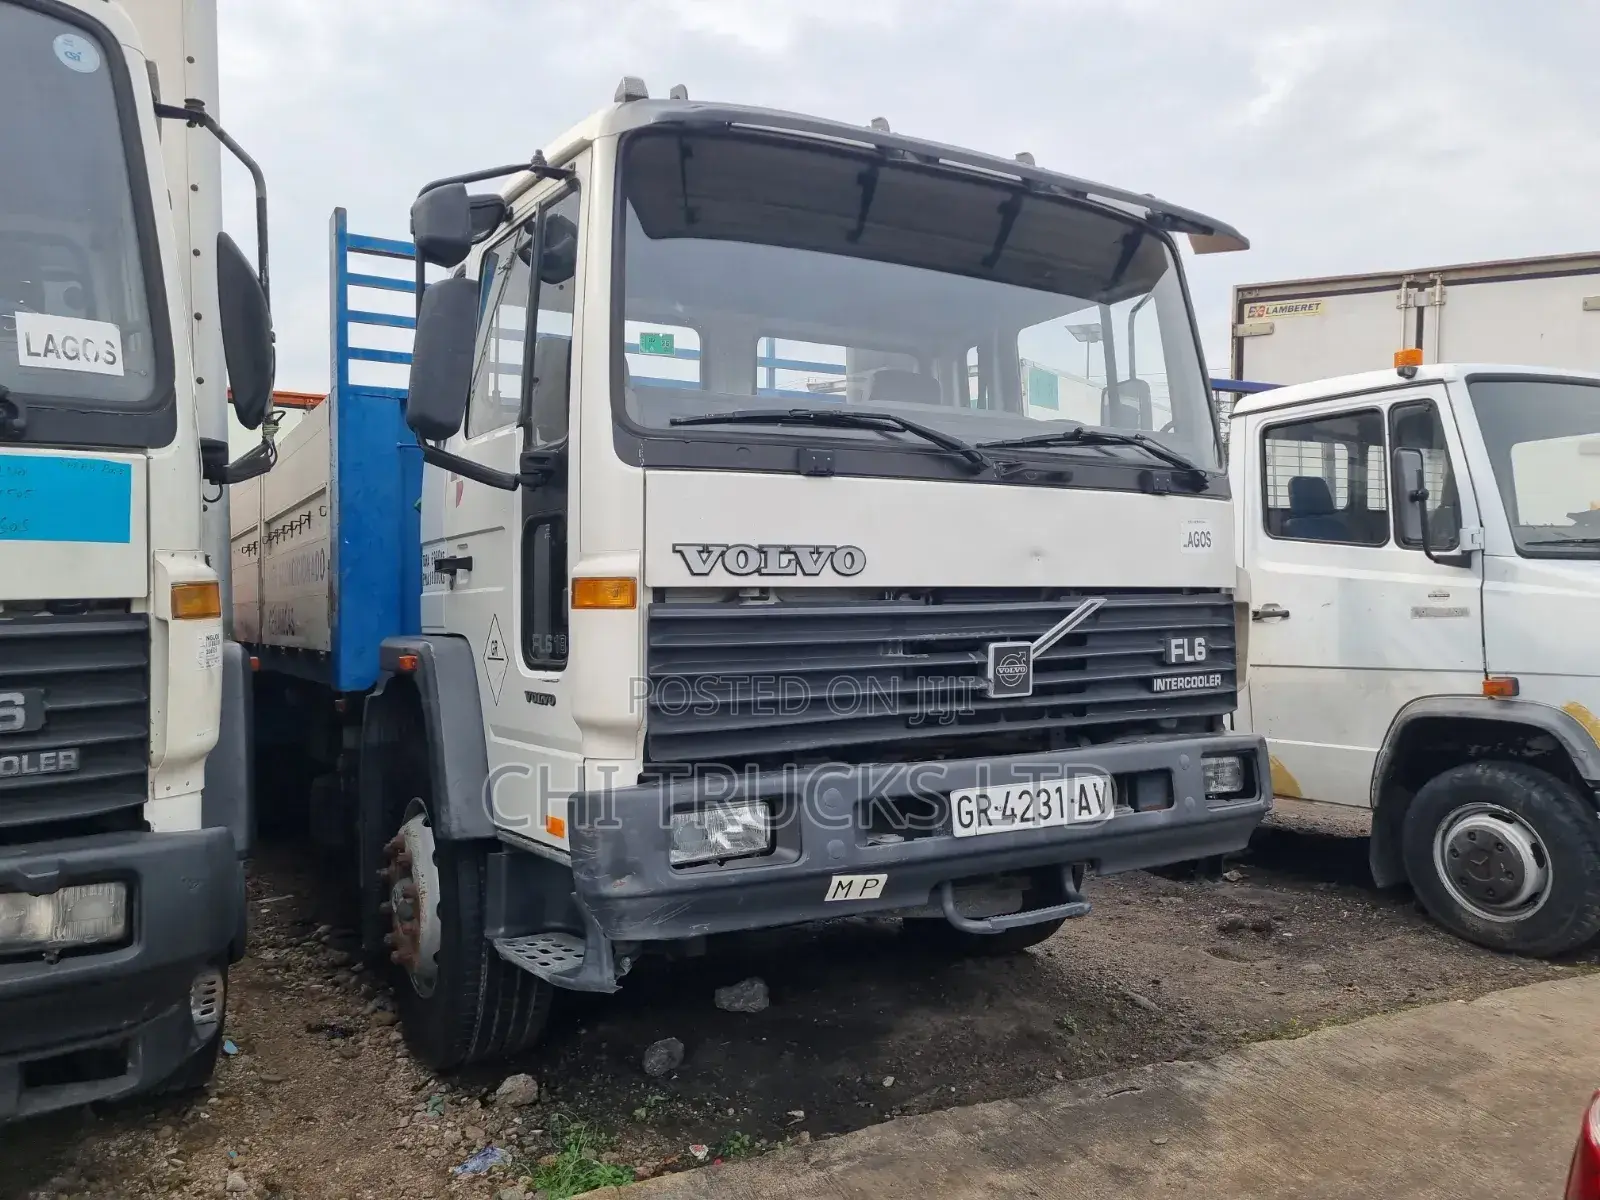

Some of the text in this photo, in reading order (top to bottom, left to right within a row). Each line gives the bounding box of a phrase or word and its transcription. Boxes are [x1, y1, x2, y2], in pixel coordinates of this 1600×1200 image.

[1265, 303, 1321, 315] LAMBERET
[25, 331, 117, 366] LAGOS
[1183, 530, 1212, 548] AGOS
[672, 542, 867, 576] VOLVO
[1170, 637, 1206, 663] FL6
[1153, 674, 1222, 692] INTERCOOLER
[524, 690, 557, 707] VOLVO
[832, 878, 880, 899] M P
